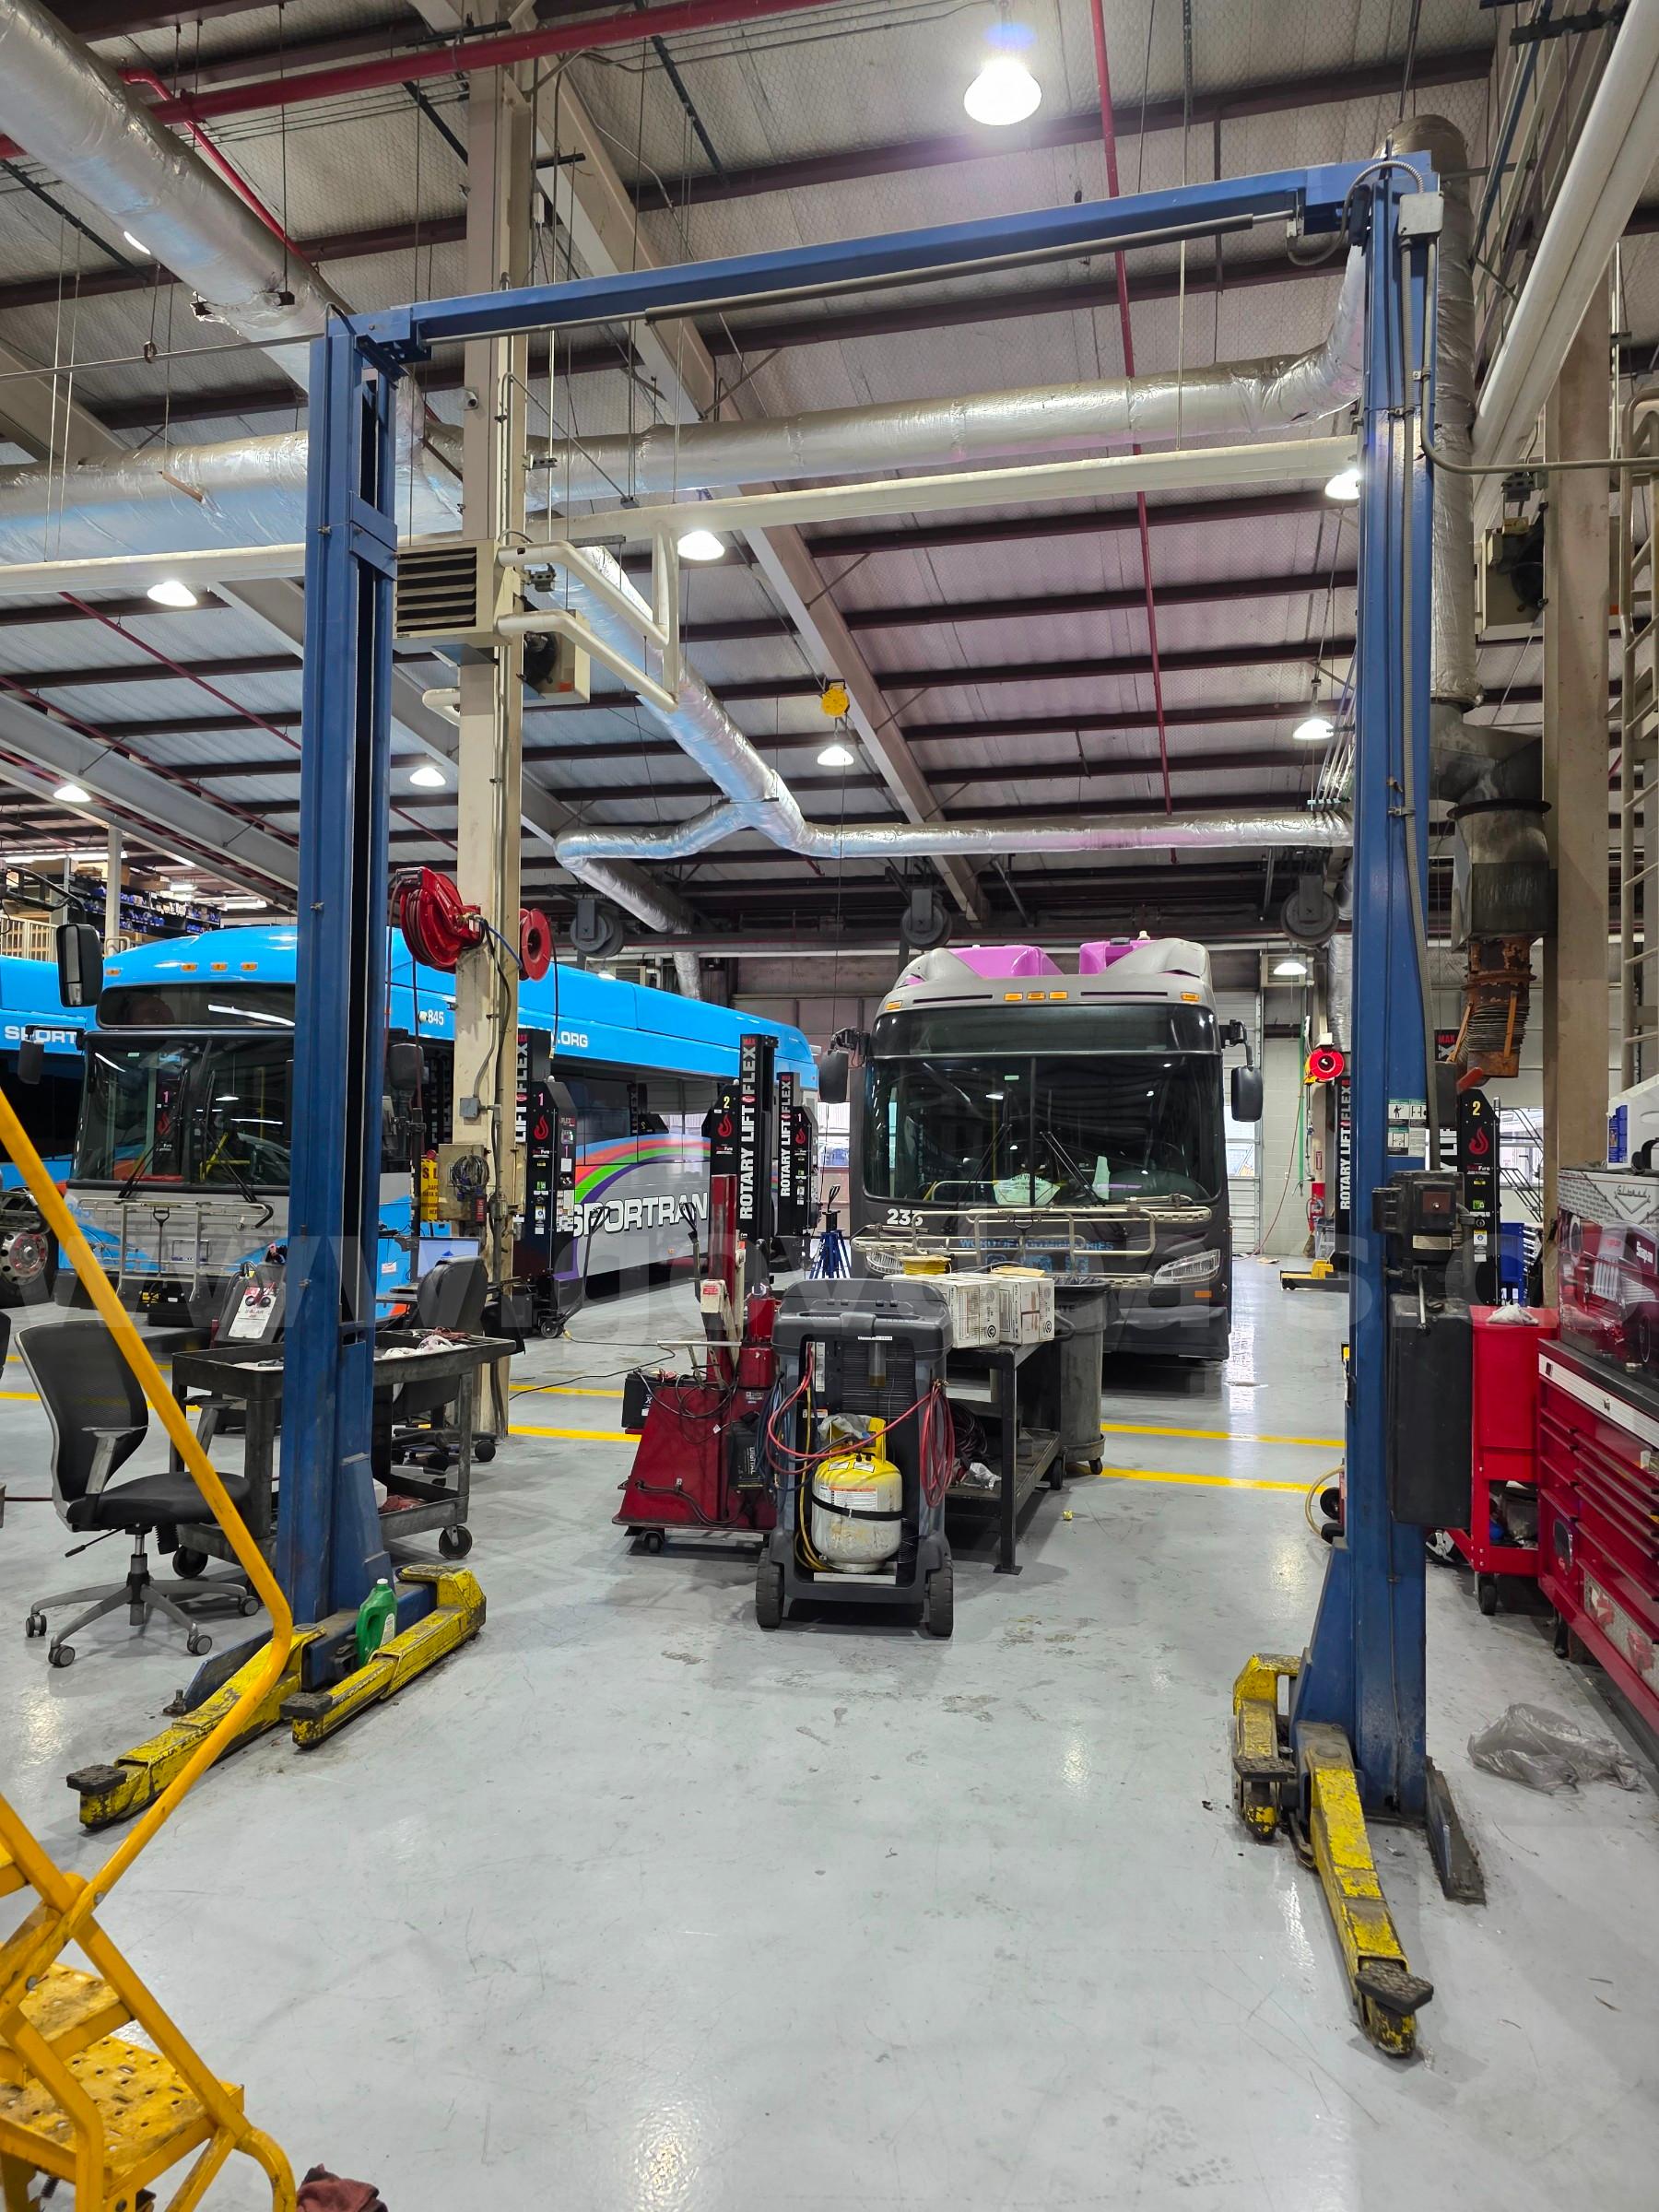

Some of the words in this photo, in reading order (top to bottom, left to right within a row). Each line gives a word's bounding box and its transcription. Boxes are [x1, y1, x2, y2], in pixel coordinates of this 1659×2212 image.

[428, 1009, 444, 1026] 845
[1438, 1033, 1456, 1044] MAX
[516, 1042, 528, 1093] FLEX
[742, 1046, 756, 1095] FLEX
[538, 1092, 544, 1106] 1
[724, 1096, 730, 1109] 2
[782, 1080, 792, 1112] FLEX
[1341, 1087, 1351, 1121] FLEX
[1472, 1100, 1481, 1116] 2
[741, 1105, 755, 1142] LIFT
[781, 1120, 791, 1145] LIFT
[797, 1112, 802, 1123] 1
[1340, 1127, 1351, 1155] LIFT
[740, 1147, 755, 1219] ROTARY
[781, 1147, 791, 1197] ROTARY
[1339, 1158, 1351, 1210] ROTARY
[573, 1192, 708, 1238] SPORTRAN
